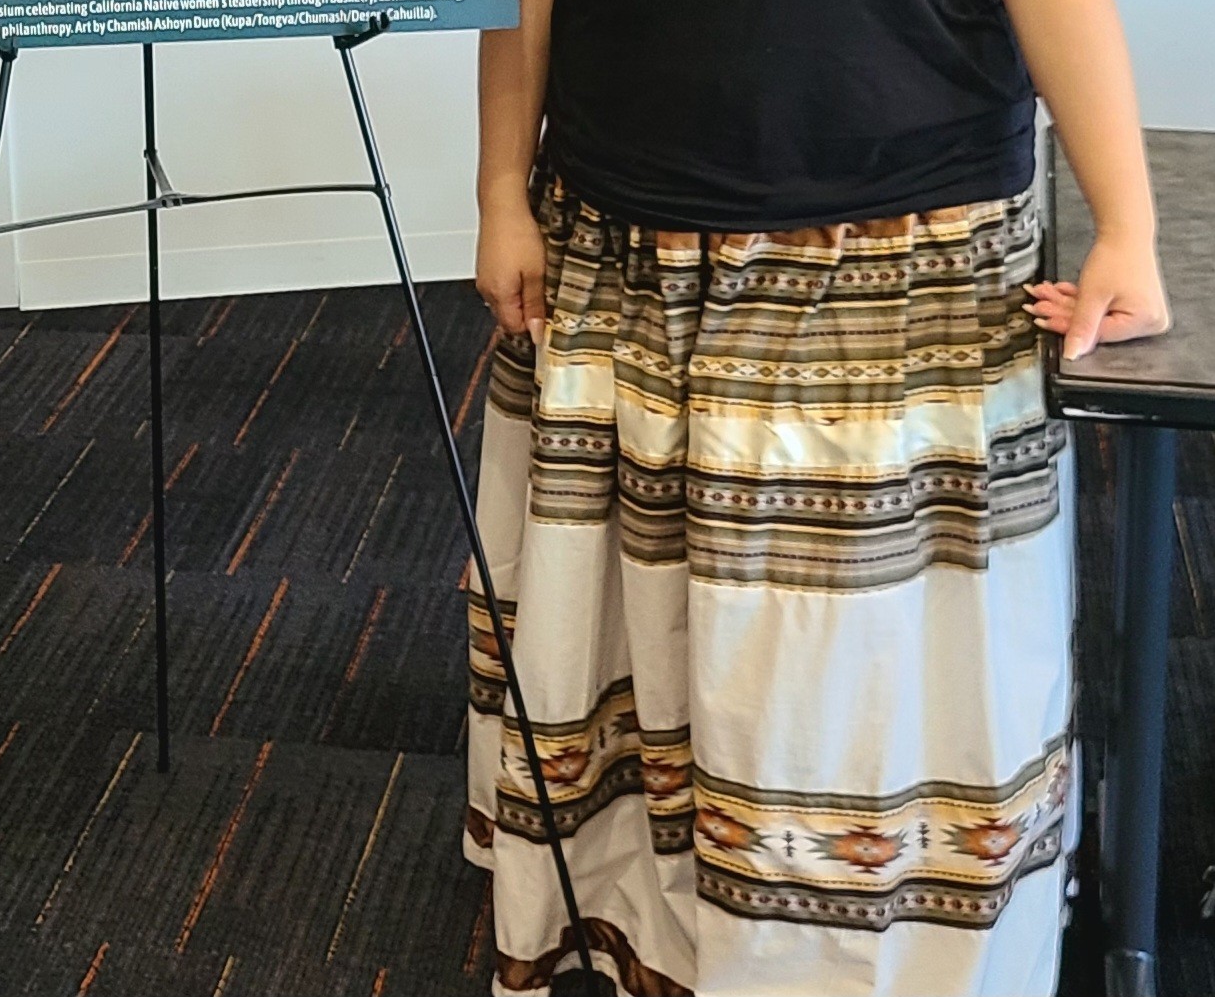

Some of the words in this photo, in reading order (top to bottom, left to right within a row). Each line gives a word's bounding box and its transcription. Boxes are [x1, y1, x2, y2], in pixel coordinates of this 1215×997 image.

[25, 2, 88, 17] celebrating
[1, 22, 73, 39] philanthropy.
[75, 20, 92, 33] Art
[93, 20, 106, 35] by
[107, 17, 154, 33] Chamish
[154, 16, 192, 33] Ashoyn
[193, 15, 220, 29] Duro
[221, 7, 387, 30] (Kupa/Tongva/Chumash/Deser
[387, 5, 437, 21] Cahuilla).
